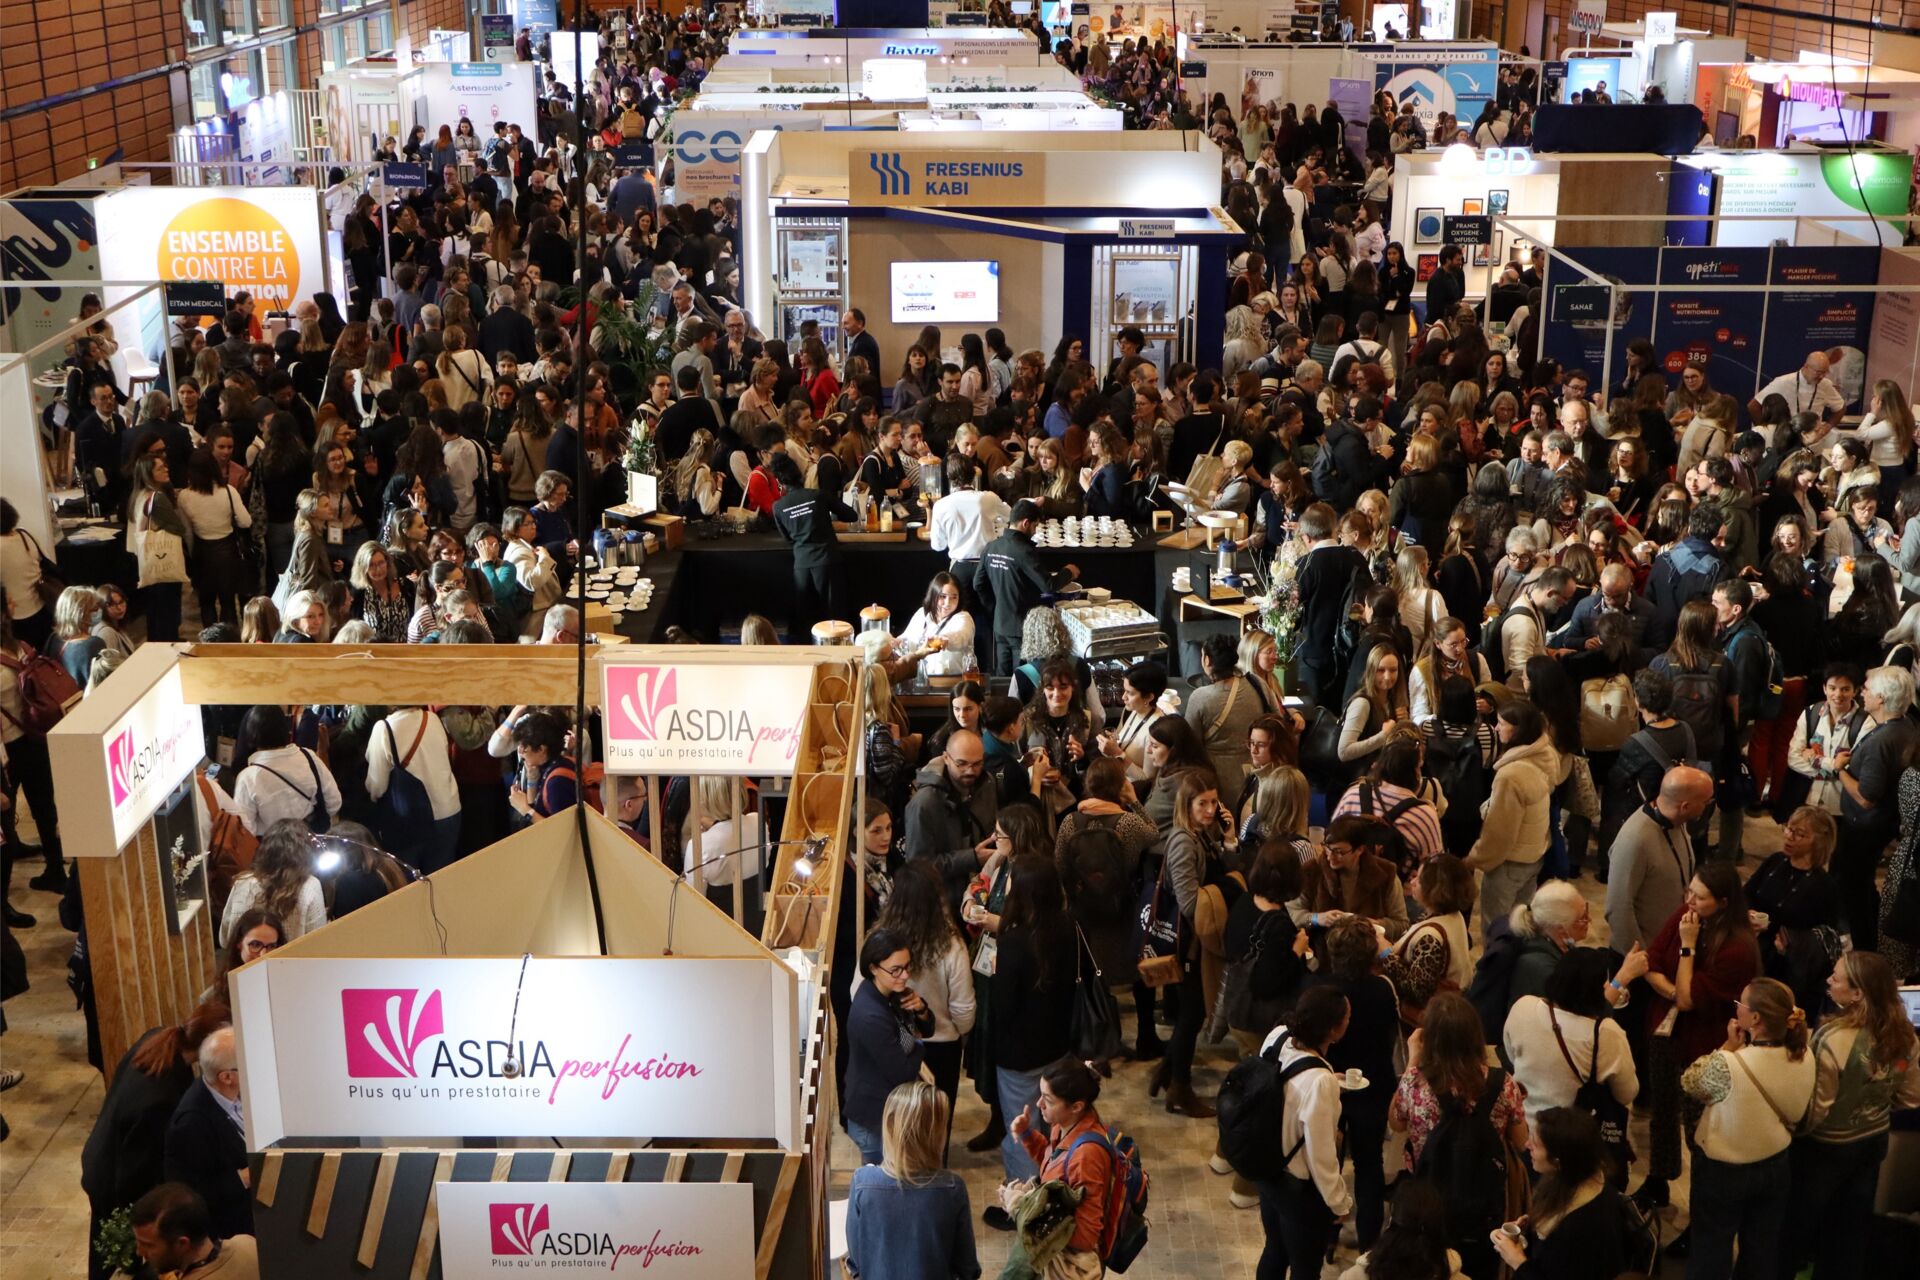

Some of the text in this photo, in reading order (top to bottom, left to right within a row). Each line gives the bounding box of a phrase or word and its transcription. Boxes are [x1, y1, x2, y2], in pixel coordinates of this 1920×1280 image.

[1571, 9, 1604, 37] wegovy
[886, 46, 936, 55] Baxter
[925, 163, 1023, 177] FRESENIUS
[1485, 147, 1532, 175] BD
[925, 182, 968, 195] KABI
[168, 231, 284, 252] ENSEMBLE
[172, 257, 287, 279] CONTRE LA
[667, 709, 754, 741] ASDIA
[133, 737, 161, 788] ASDIA
[609, 746, 743, 759] Plus qu'un prestataire
[431, 1034, 704, 1105] ASDIA perfusion
[349, 1085, 541, 1100] Plus qu'un prestataire
[541, 1229, 703, 1271] ASDIA perfusion
[492, 1259, 607, 1269] Plus qu'un prestataire
